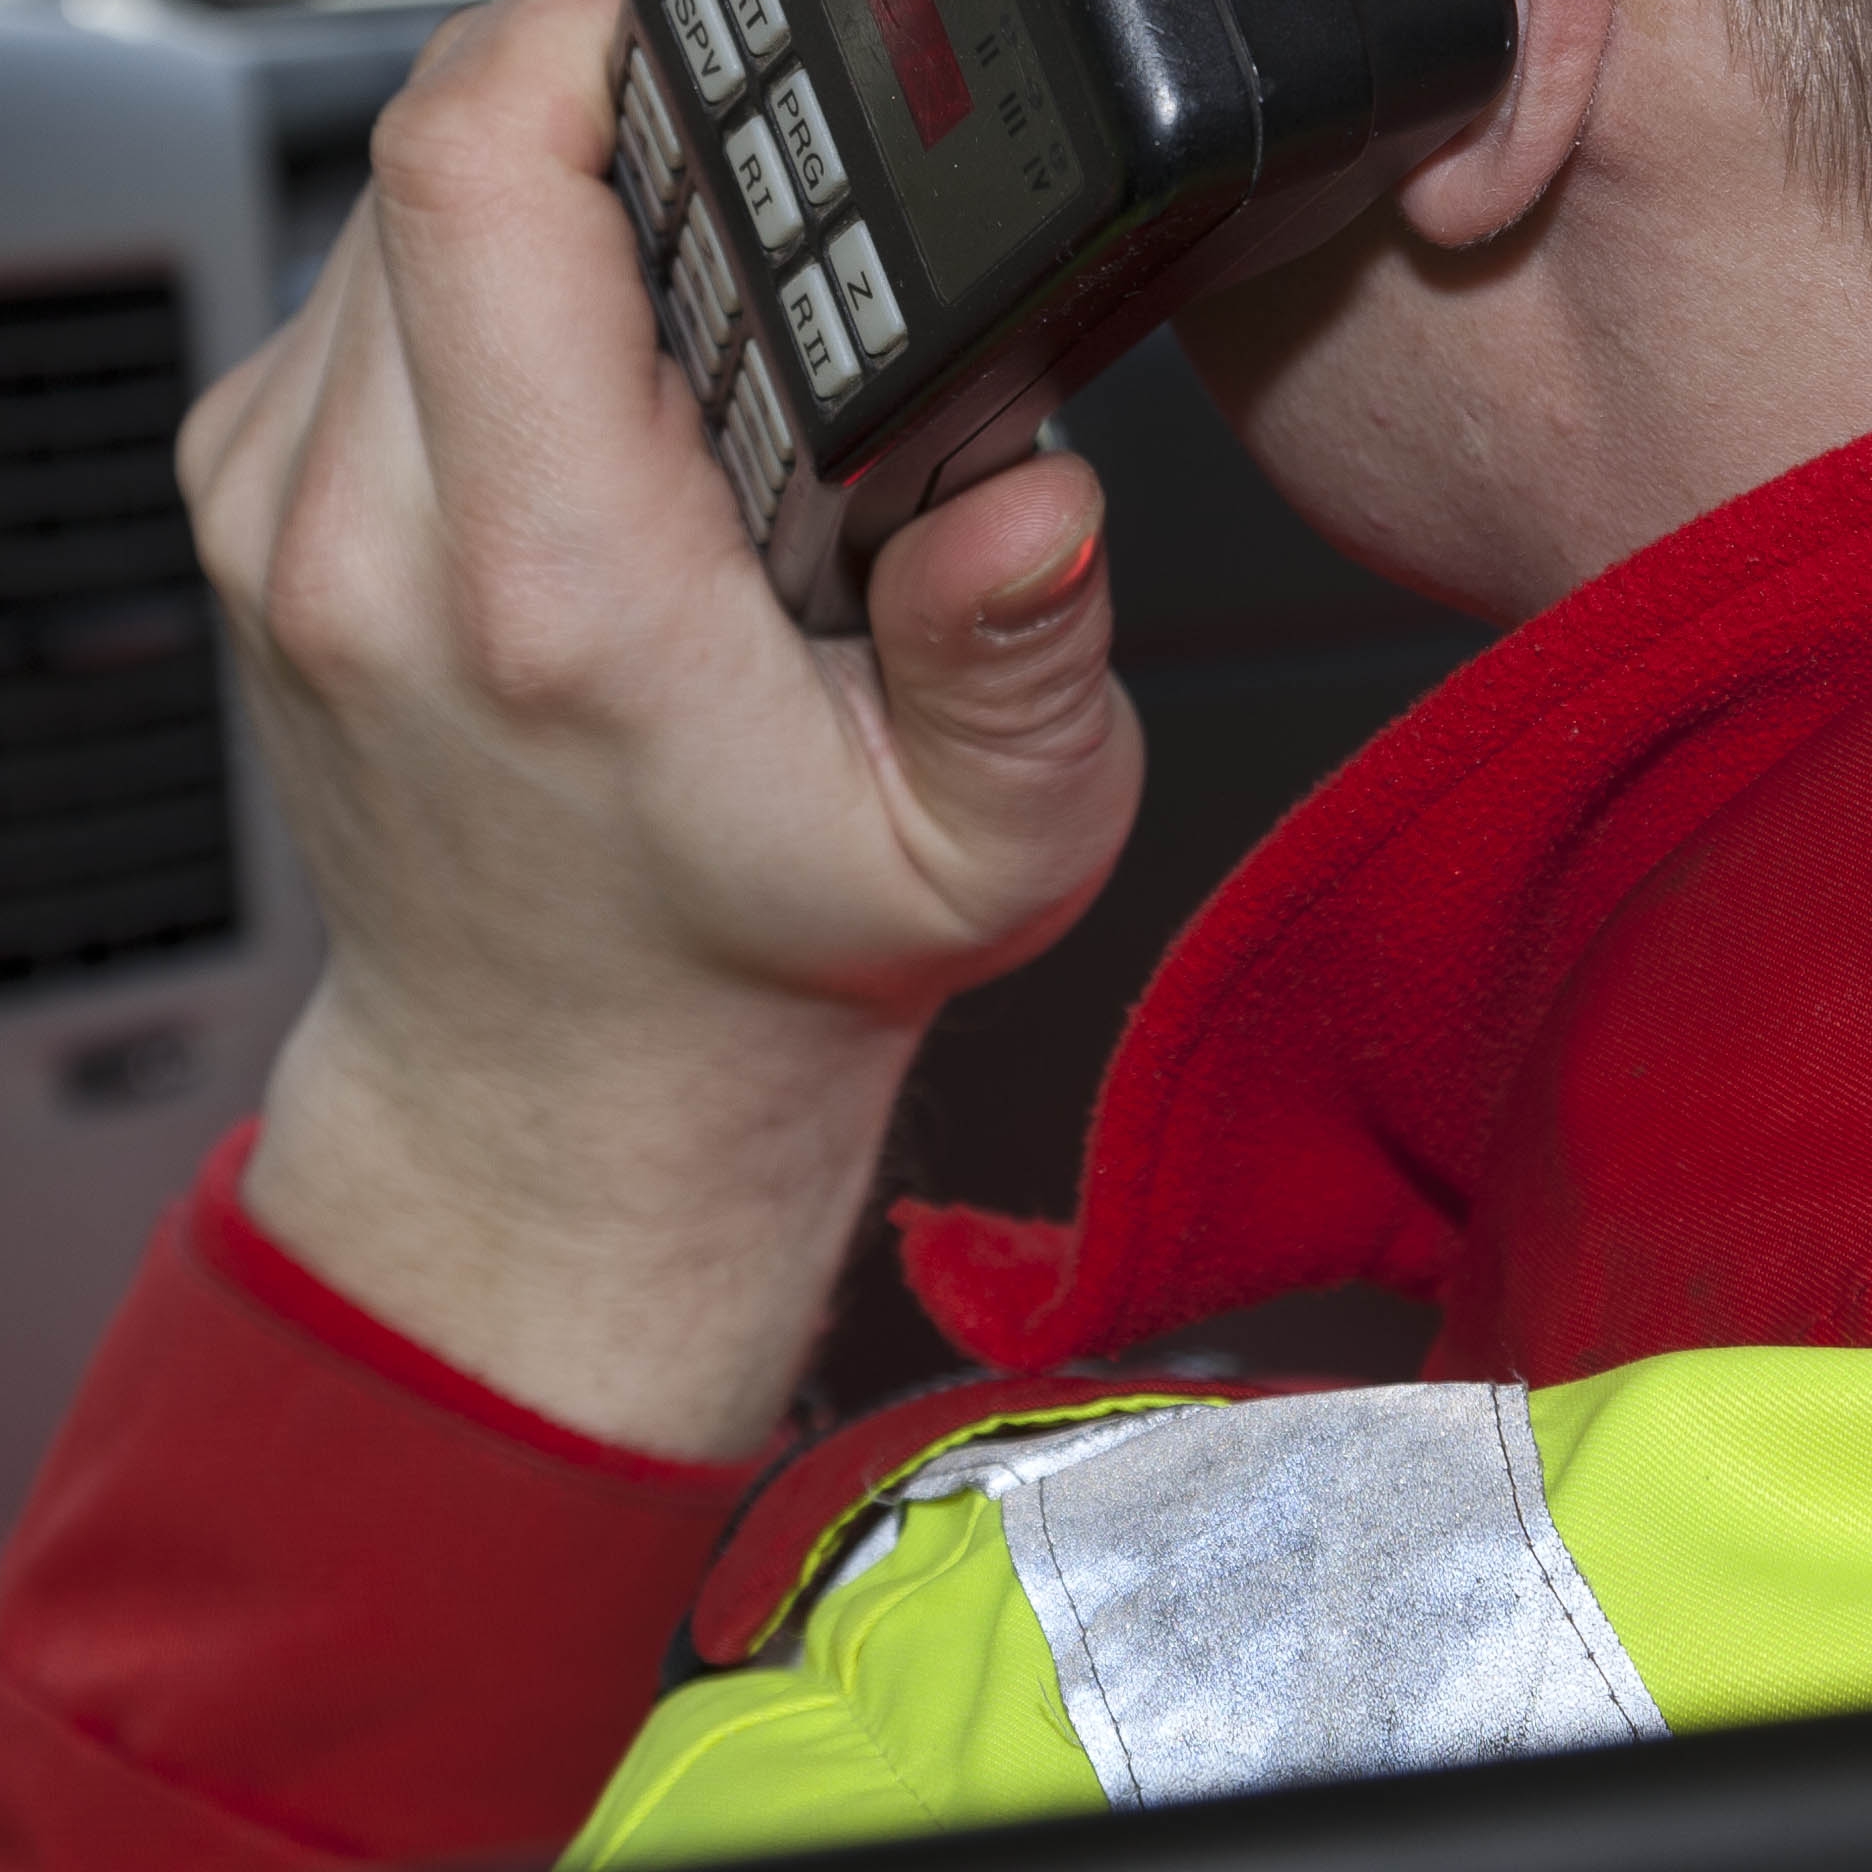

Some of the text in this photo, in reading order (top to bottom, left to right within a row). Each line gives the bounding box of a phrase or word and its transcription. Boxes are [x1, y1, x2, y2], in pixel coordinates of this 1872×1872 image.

[778, 90, 824, 190] PRG
[739, 154, 772, 215] RI
[847, 272, 873, 310] Z
